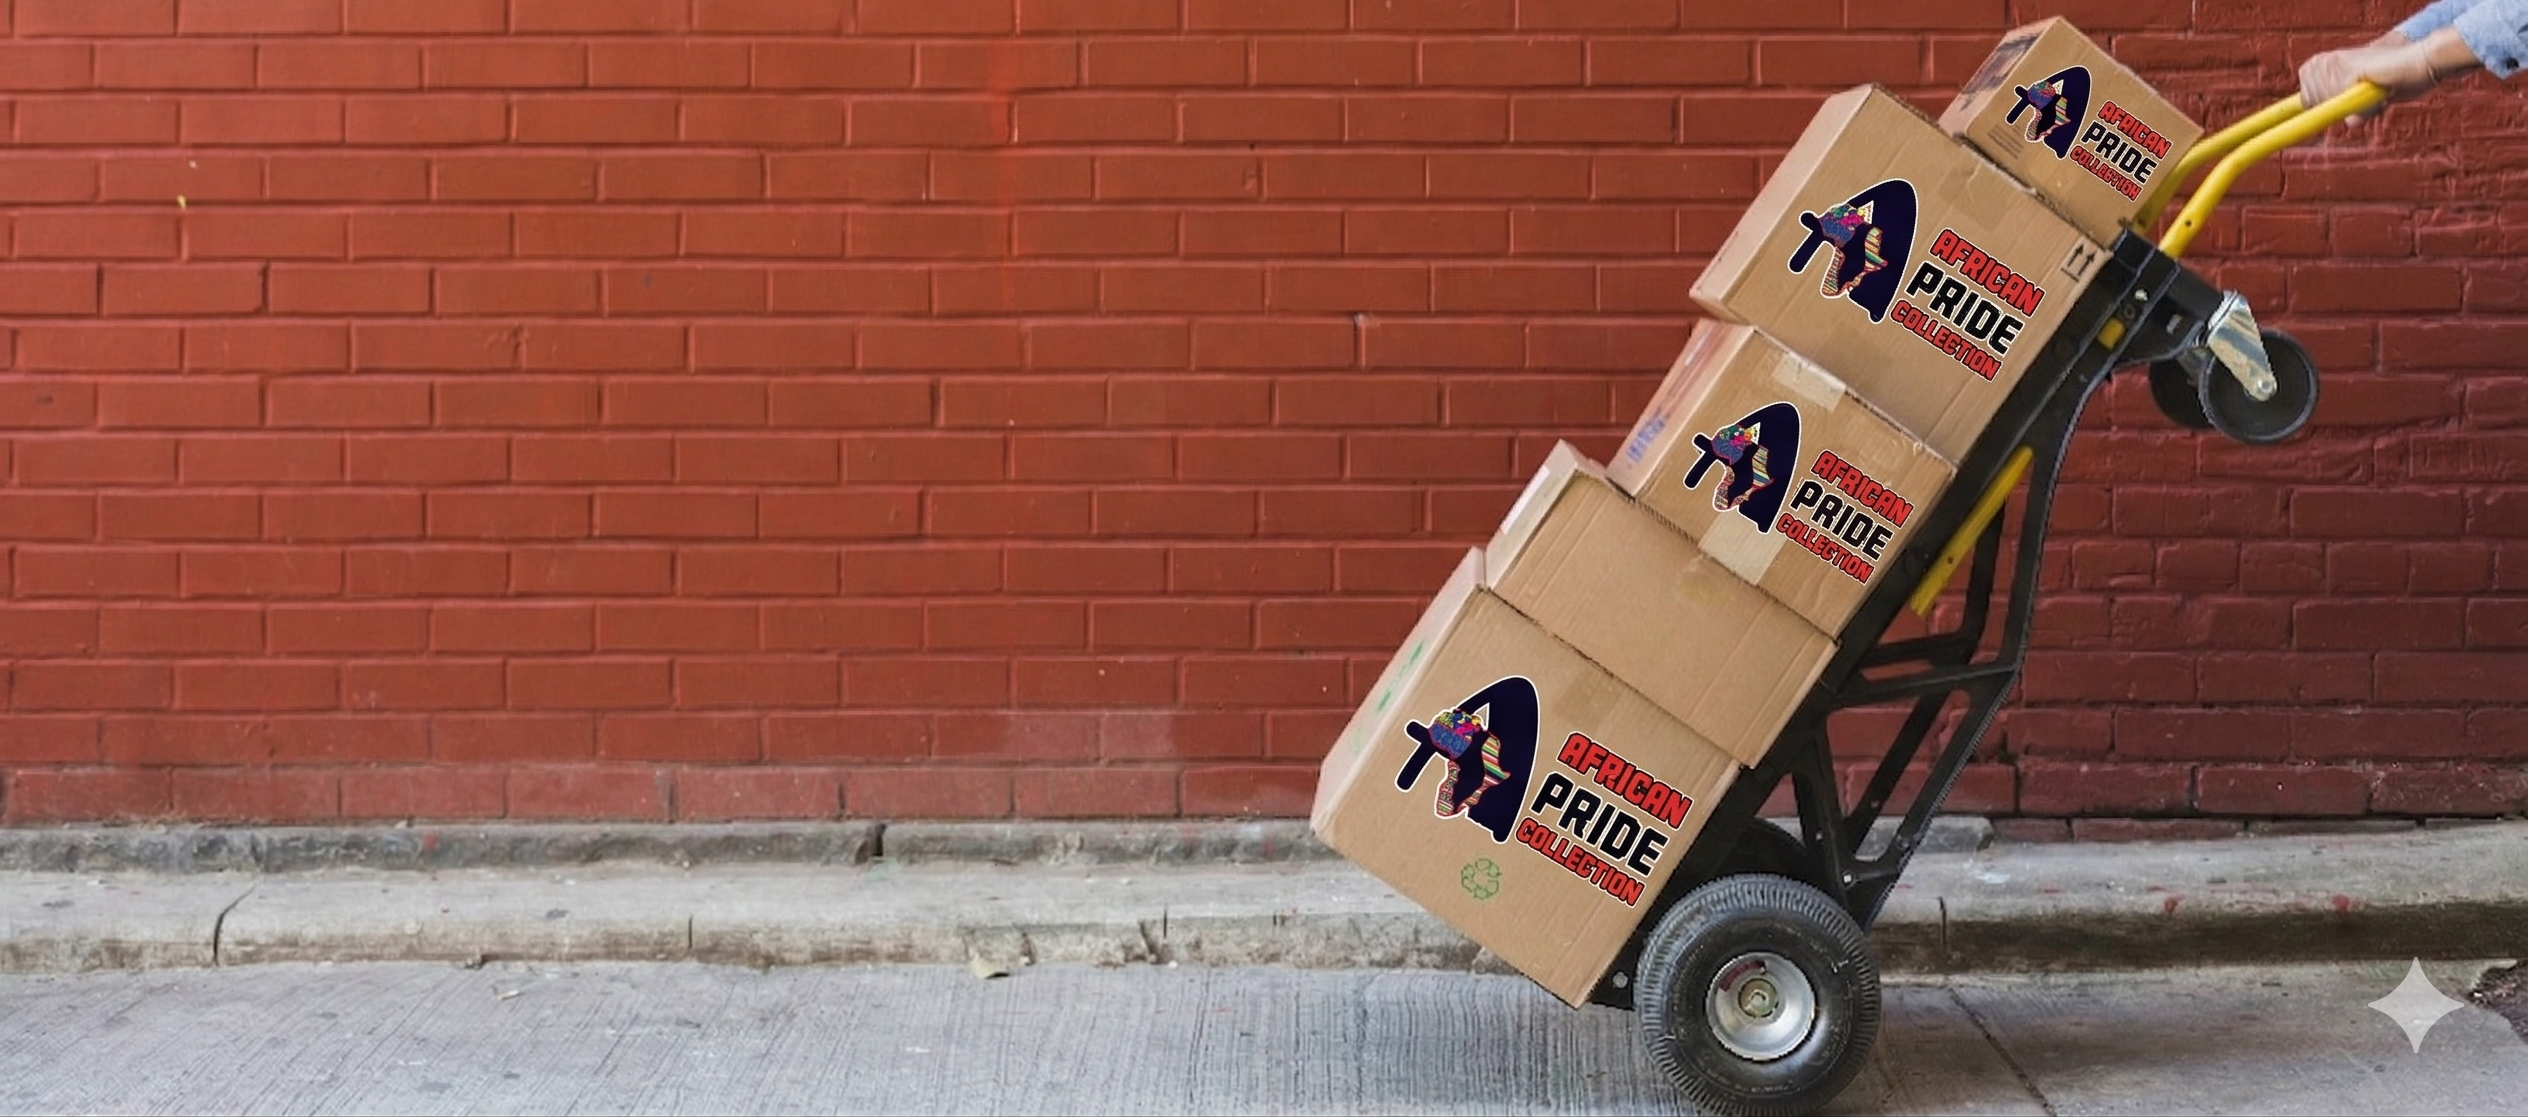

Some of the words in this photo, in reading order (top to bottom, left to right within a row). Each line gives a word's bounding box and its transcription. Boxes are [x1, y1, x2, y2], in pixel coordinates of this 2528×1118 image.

[2081, 121, 2157, 183] PRIDE
[2098, 101, 2172, 159] AFRICAN
[1906, 263, 2023, 354] PRIDE
[1930, 229, 2044, 317] AFRICAN
[1891, 300, 2001, 381] COLLECTION
[1791, 481, 1892, 560] PRIDE
[1811, 450, 1913, 527] AFRICAN
[1776, 513, 1874, 584] COLLECTION
[1558, 732, 1692, 829] AFRICAN
[1516, 818, 1645, 906] COLLECTION
[1531, 773, 1667, 876] PRIDE
